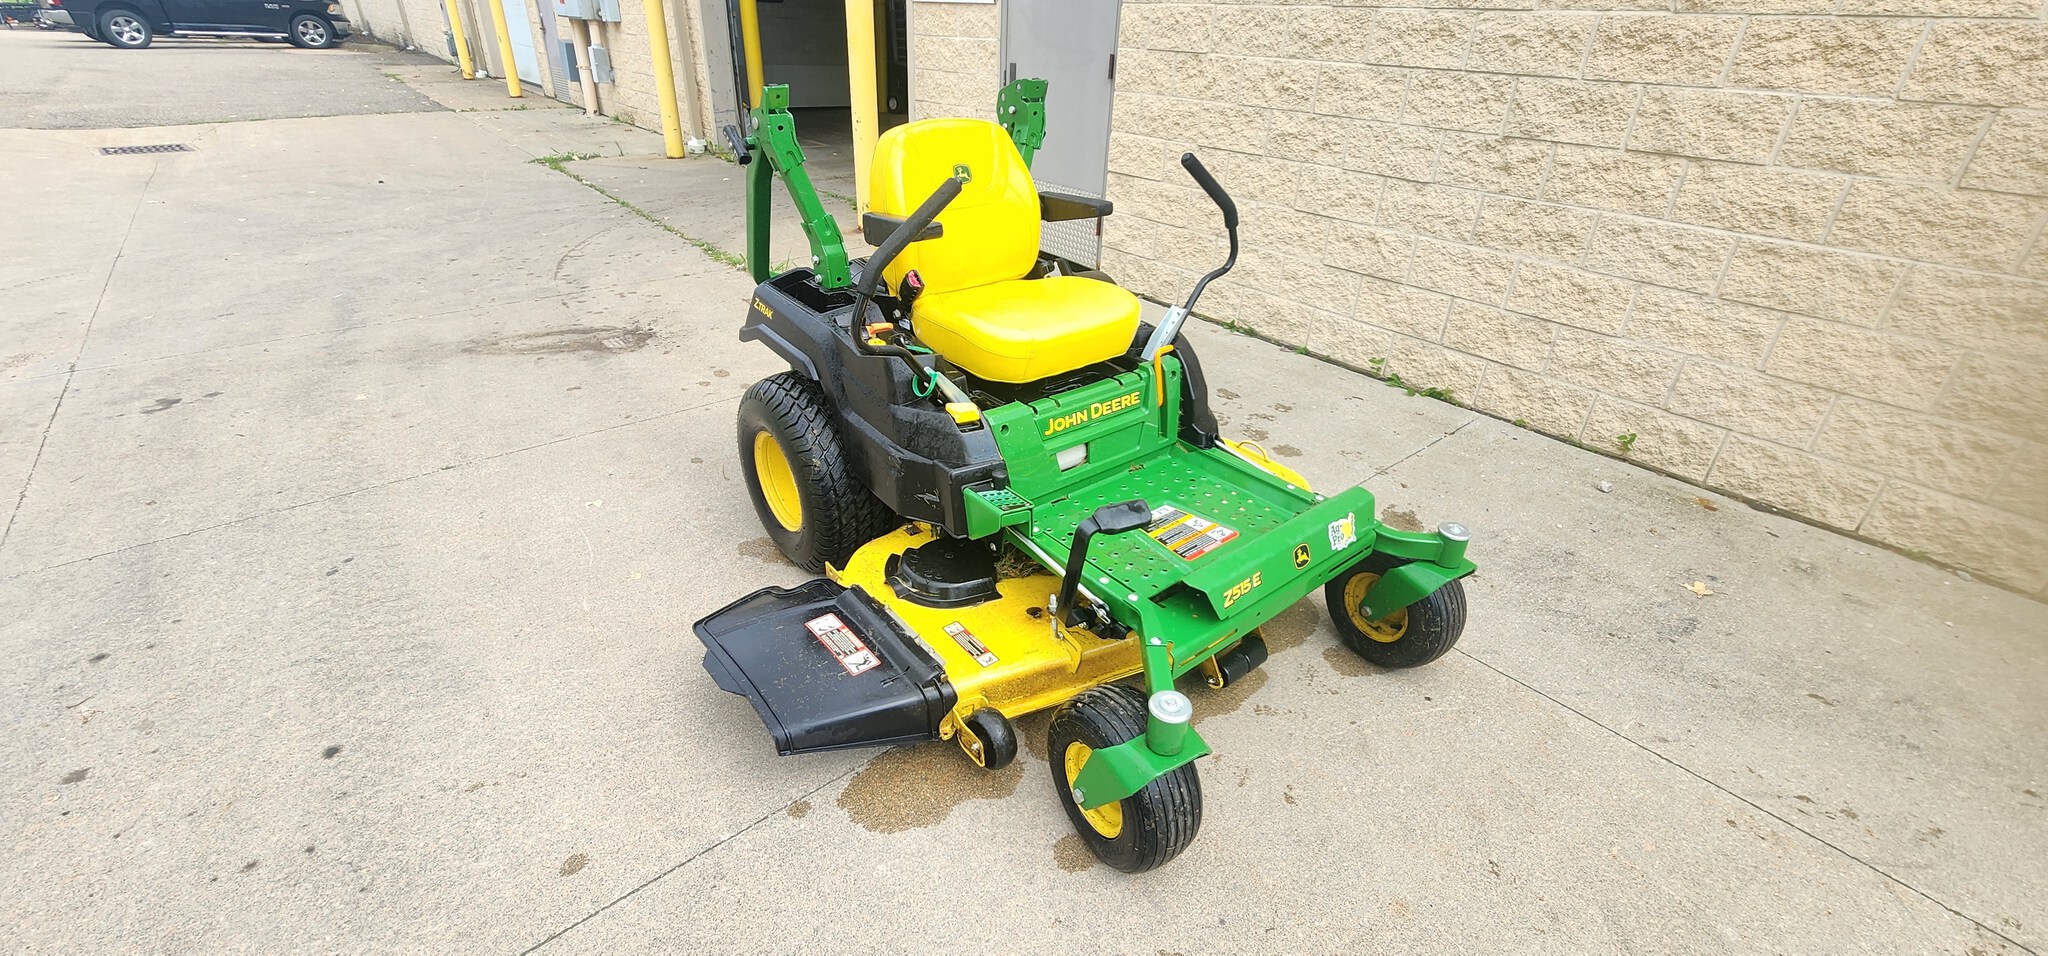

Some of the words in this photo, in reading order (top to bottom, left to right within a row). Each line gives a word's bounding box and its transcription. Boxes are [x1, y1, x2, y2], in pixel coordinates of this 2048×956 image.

[1044, 409, 1088, 436] JOHN
[1090, 391, 1141, 420] DEERE
[1223, 577, 1252, 609] Z515
[1252, 571, 1262, 588] E
